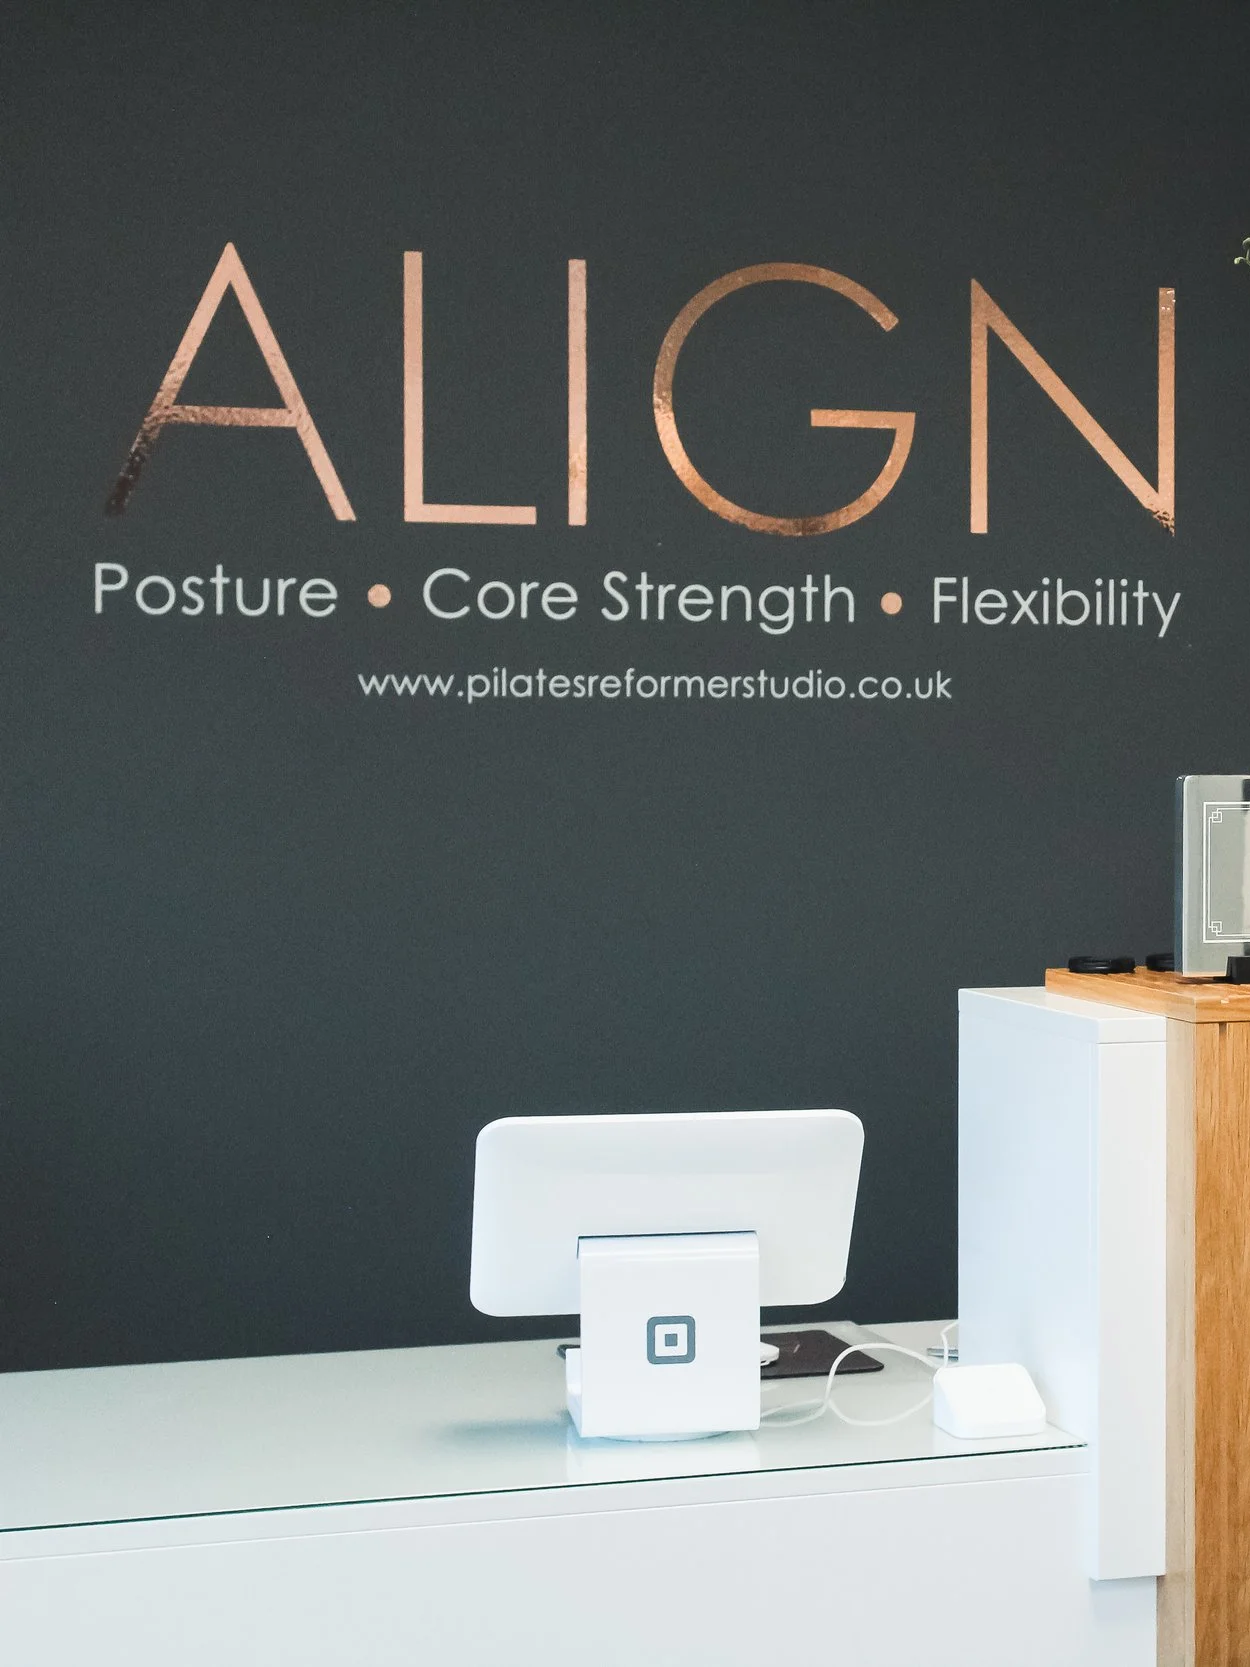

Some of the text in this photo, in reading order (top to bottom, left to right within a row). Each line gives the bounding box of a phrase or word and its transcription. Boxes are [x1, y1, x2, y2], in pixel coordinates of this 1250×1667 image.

[105, 242, 1175, 537] ALIGN
[95, 563, 1181, 637] Posture Core Strength Flexibility
[358, 668, 952, 704] www.pilatesreformerstudio.co.uk
